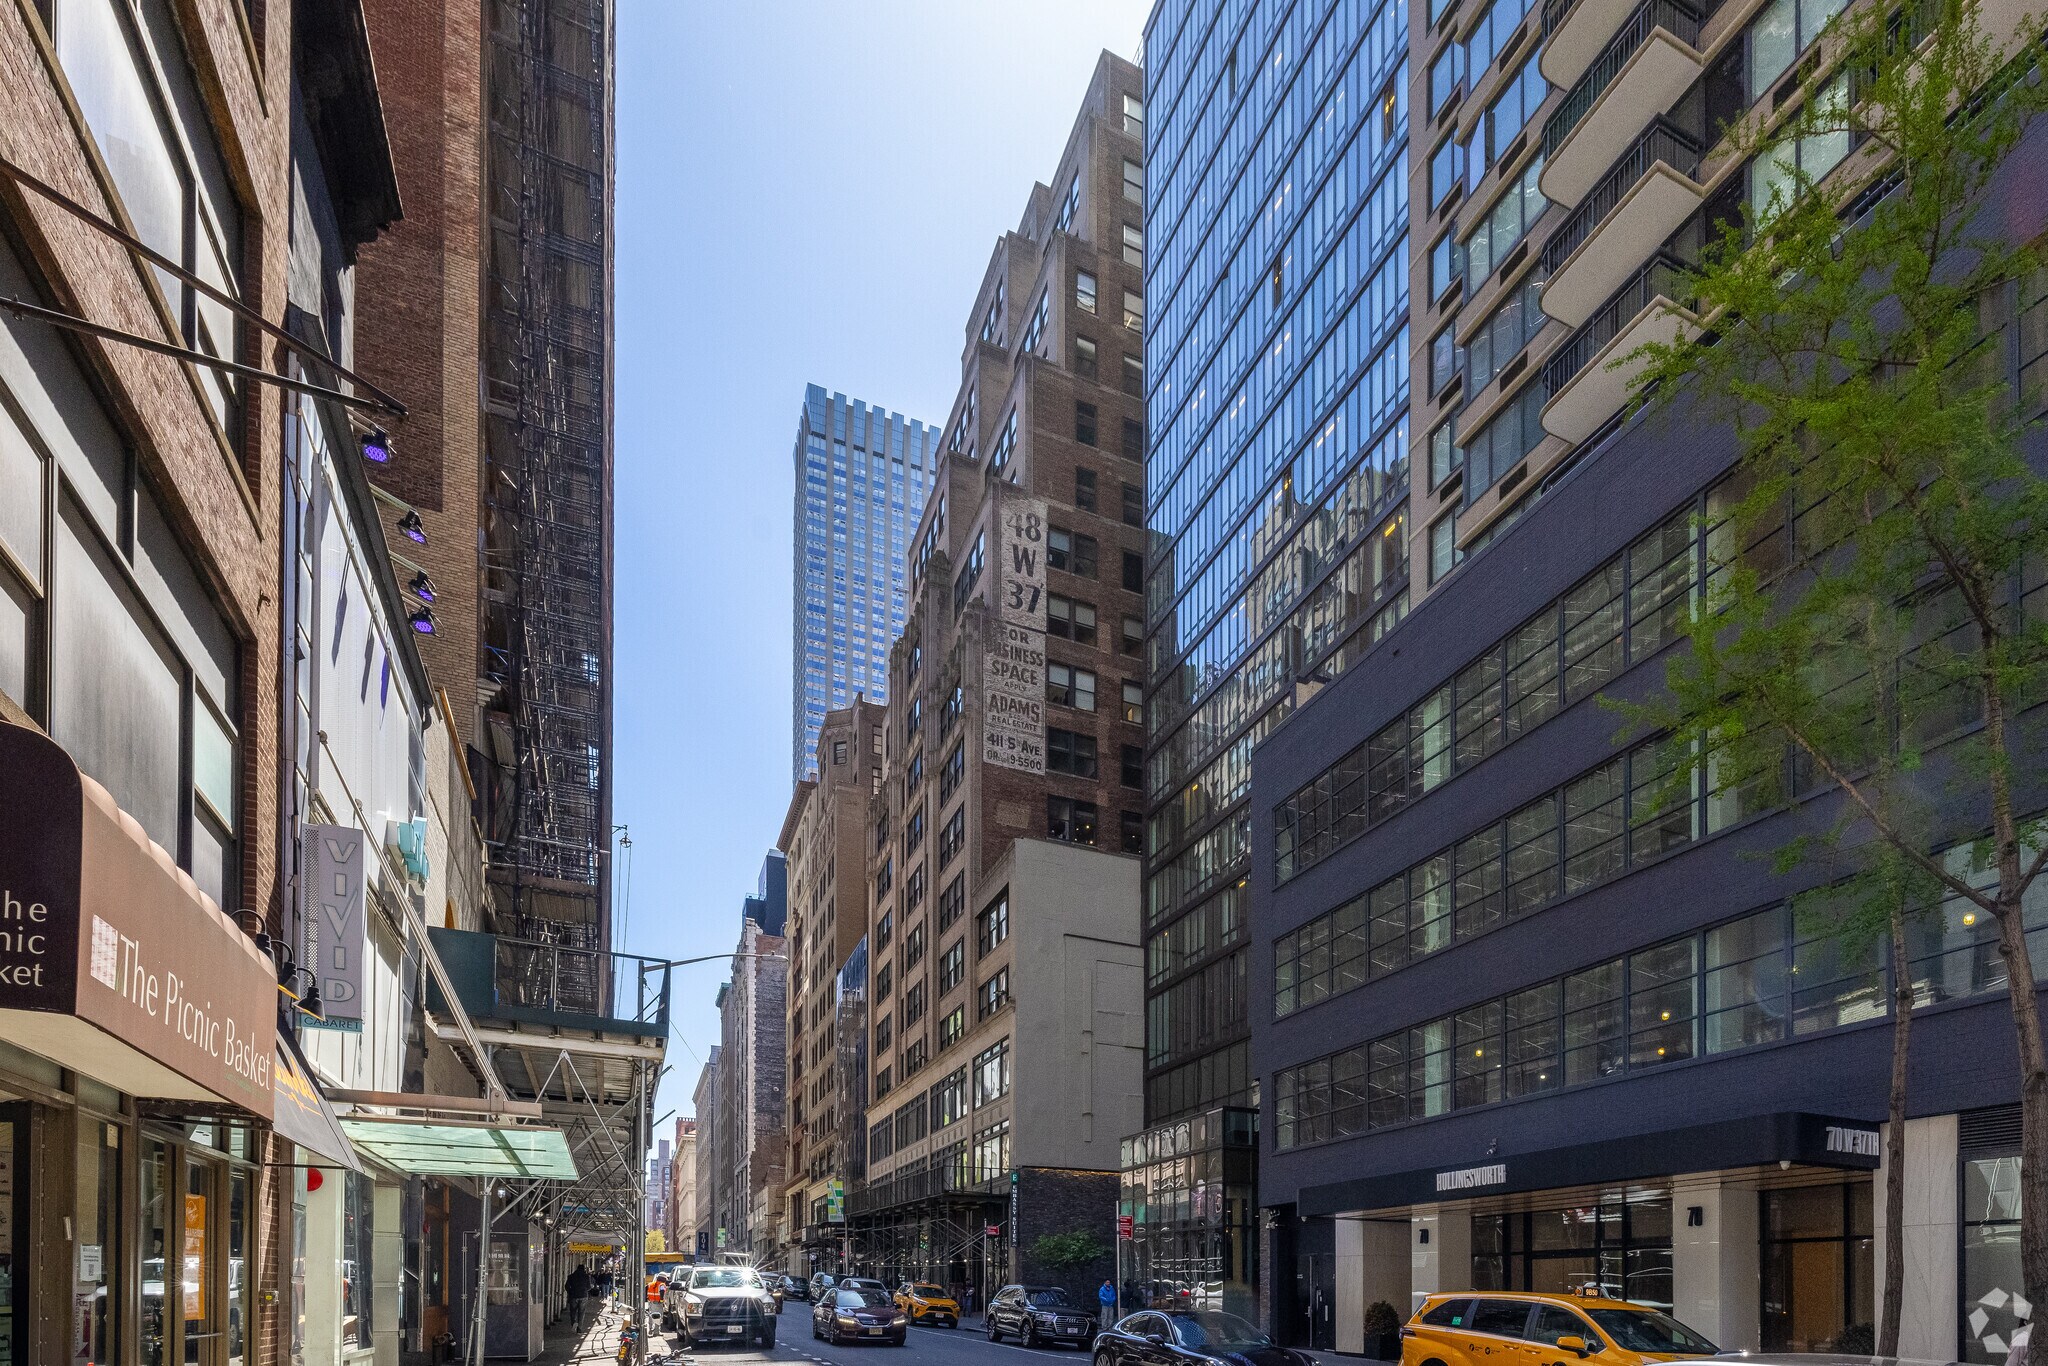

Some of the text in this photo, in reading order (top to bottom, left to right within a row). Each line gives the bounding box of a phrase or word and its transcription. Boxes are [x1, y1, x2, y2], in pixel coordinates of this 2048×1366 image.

[1006, 513, 1042, 542] 48
[1012, 543, 1036, 577] W
[991, 659, 1038, 686] SPACE
[988, 693, 1041, 724] ADAMS
[992, 714, 1038, 732] REAL ESTATE
[322, 838, 358, 1003] VIVID
[120, 933, 159, 1017] The
[164, 970, 220, 1058] Picnic
[224, 1016, 271, 1091] Basket
[304, 1016, 360, 1029] CABARET
[1436, 1164, 1507, 1192] HOLLINGSWORTH
